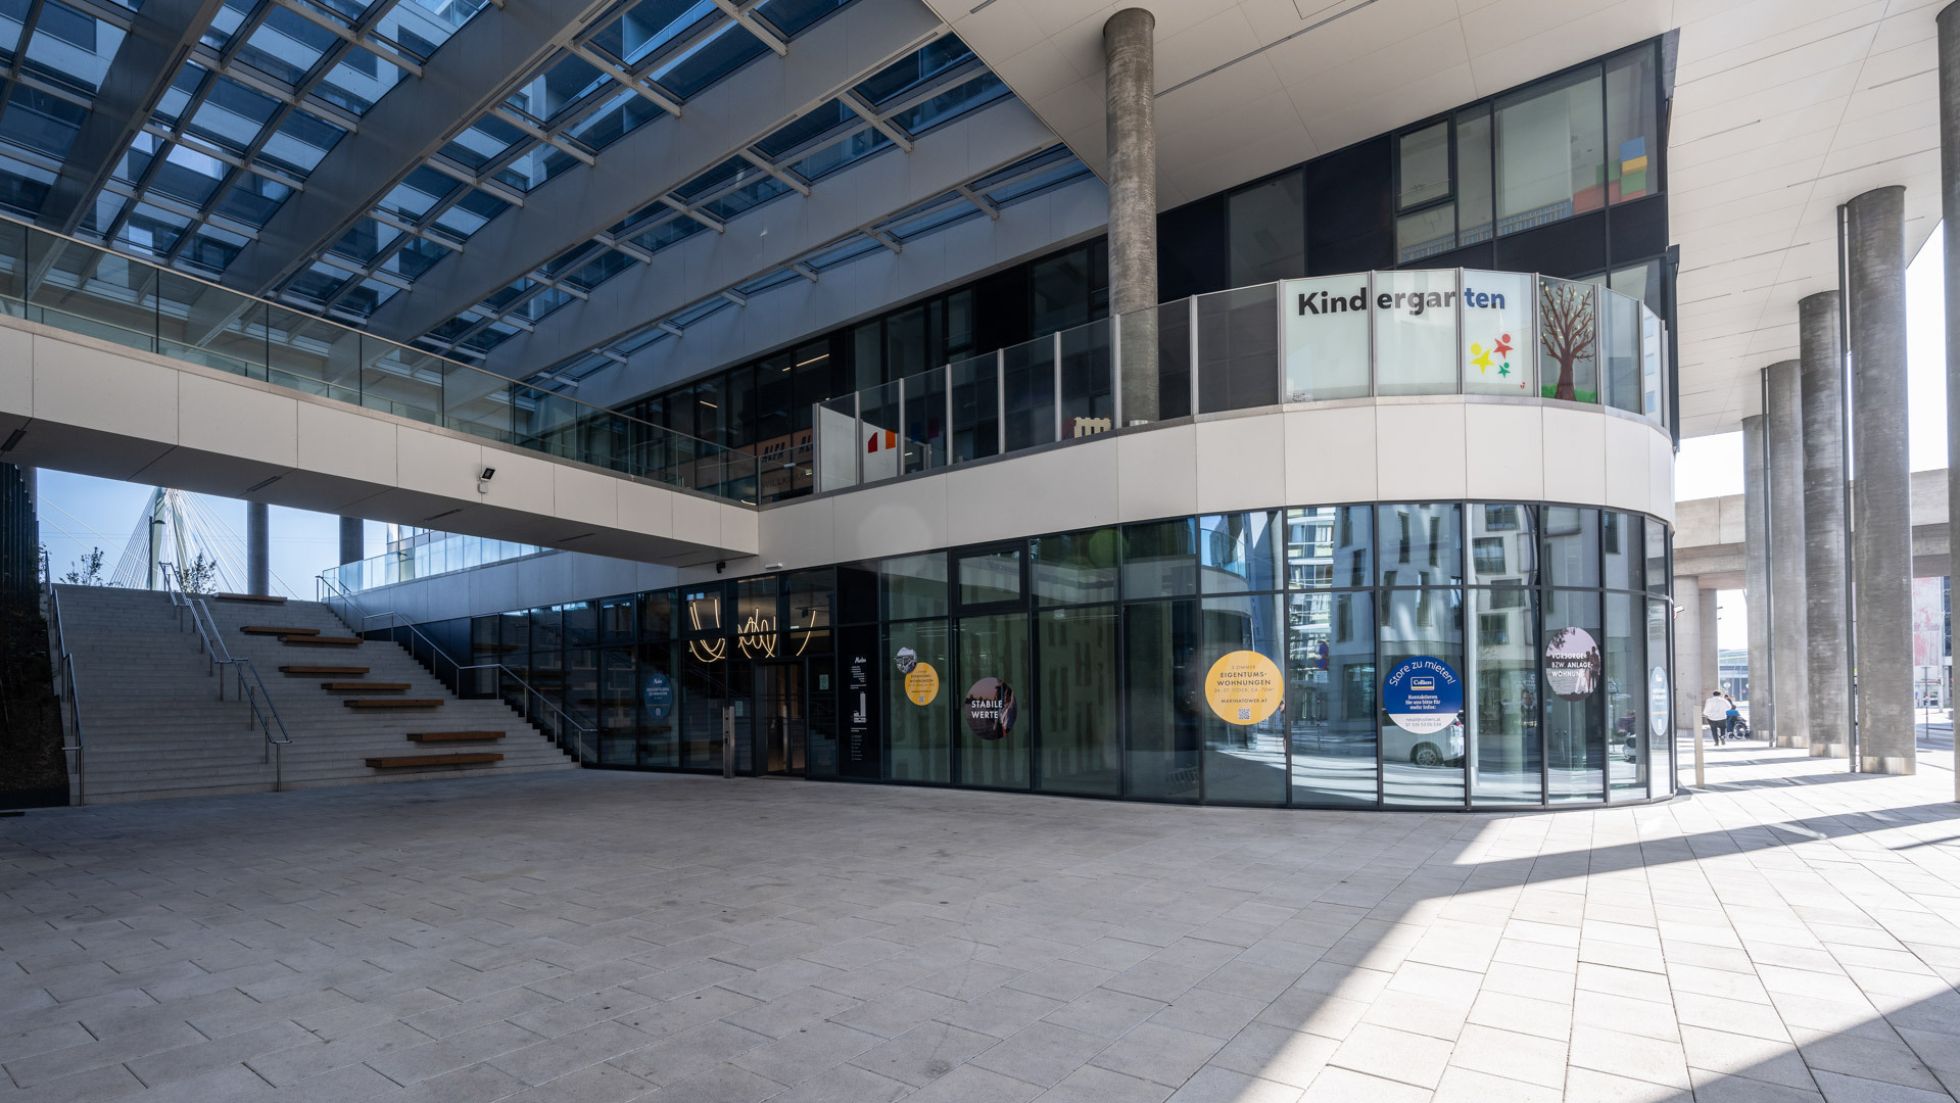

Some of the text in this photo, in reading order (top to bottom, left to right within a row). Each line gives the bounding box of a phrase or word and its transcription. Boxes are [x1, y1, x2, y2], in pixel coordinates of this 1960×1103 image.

[1298, 286, 1506, 316] Kindergarten
[1389, 660, 1457, 687] Store zu mieten!
[971, 700, 1003, 708] STABILE
[971, 710, 999, 719] WERTE
